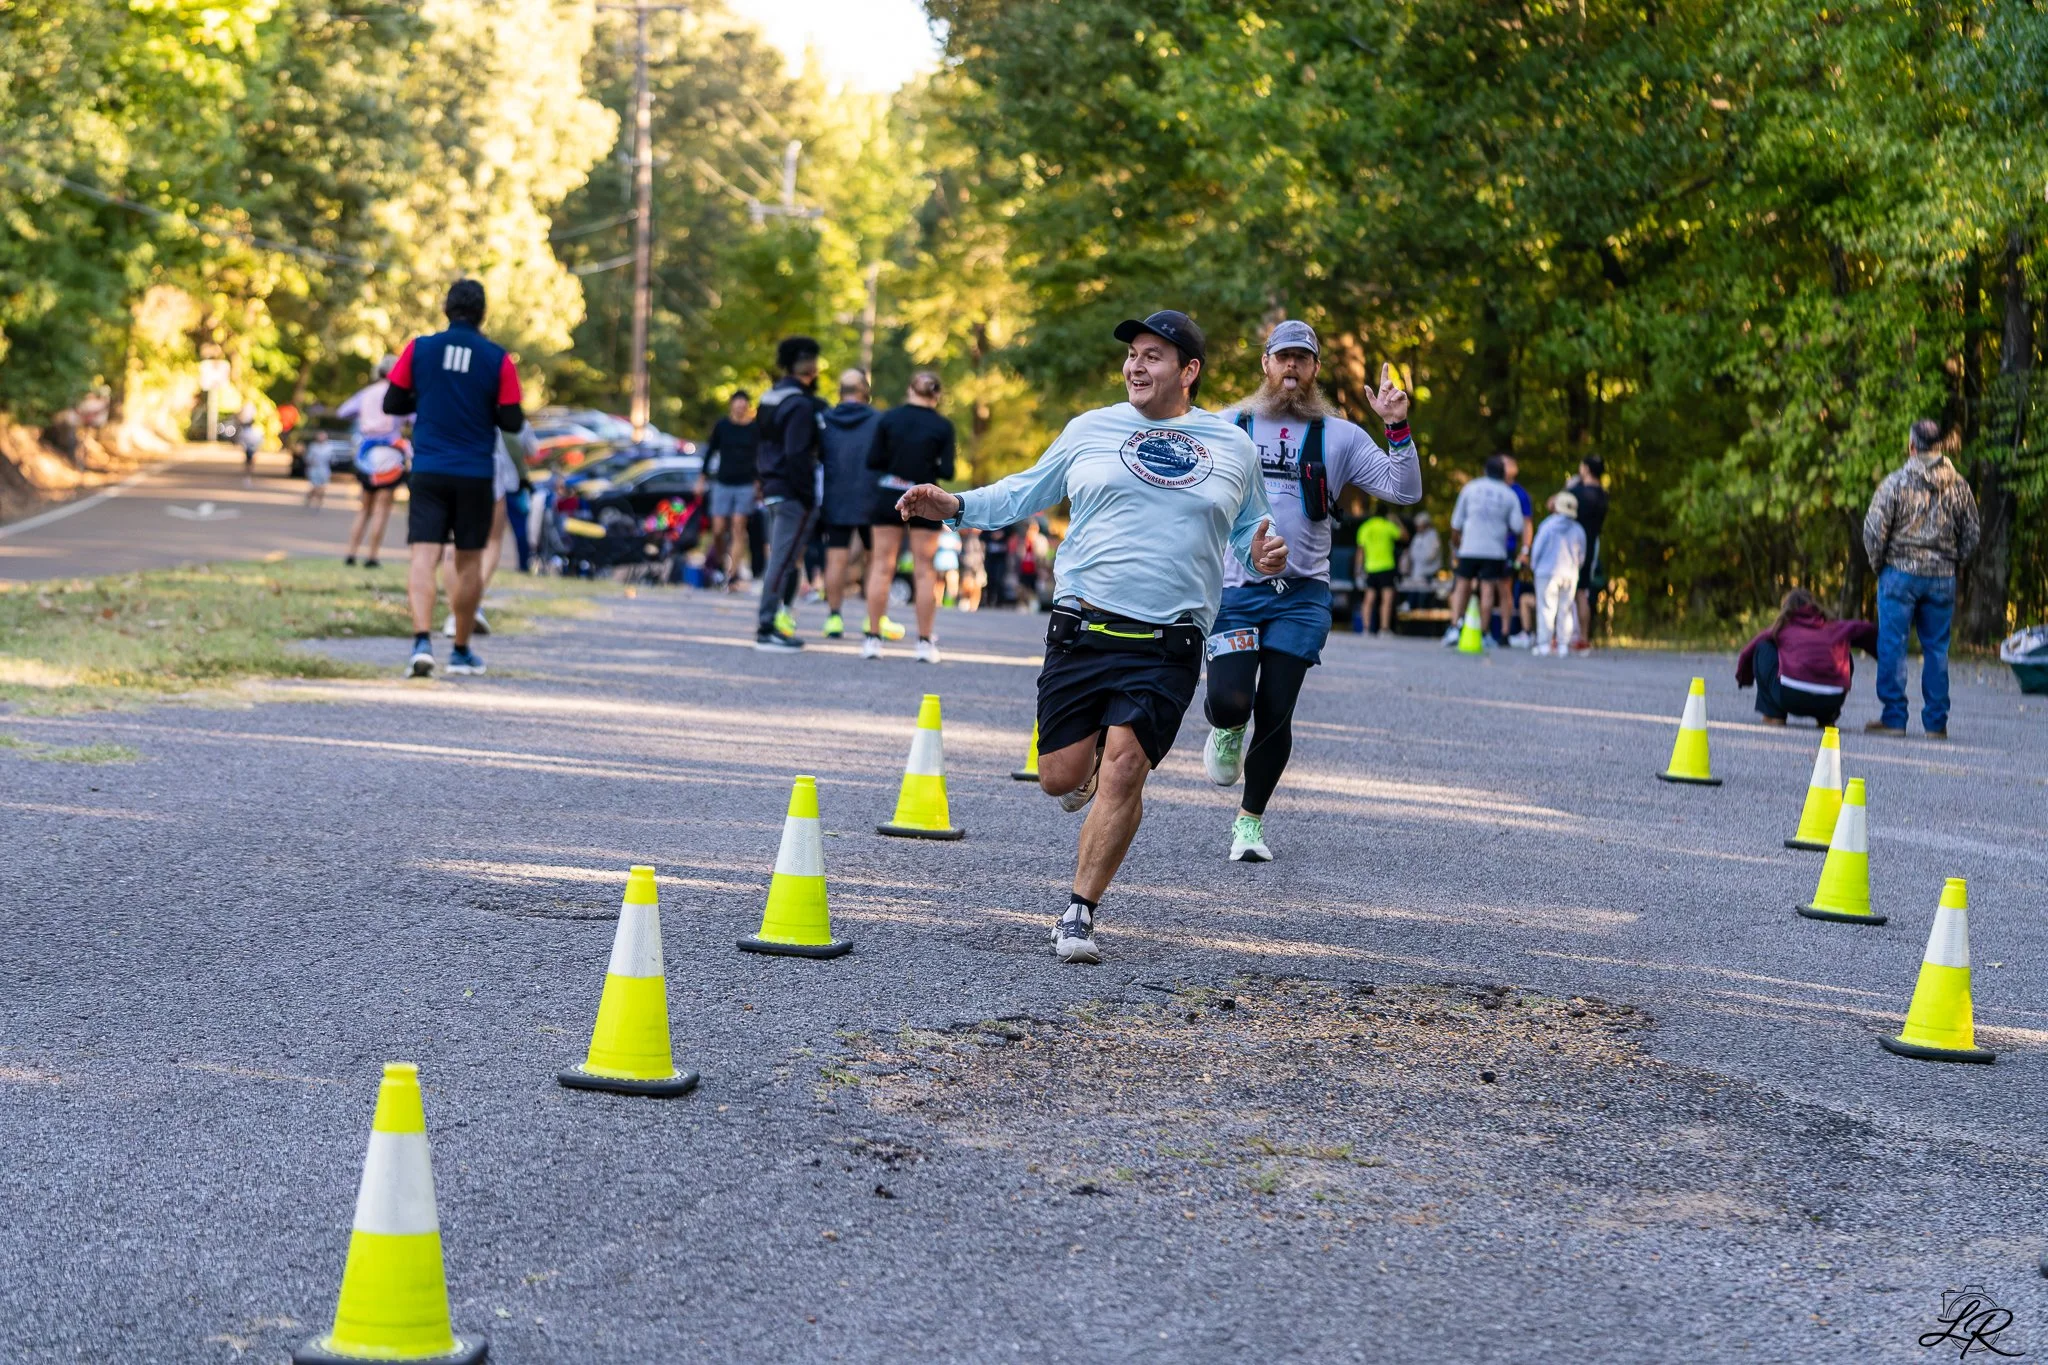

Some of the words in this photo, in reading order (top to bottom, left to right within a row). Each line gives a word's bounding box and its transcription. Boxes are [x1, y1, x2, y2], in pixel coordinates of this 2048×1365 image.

[1127, 432, 1146, 448] RAD
[1166, 432, 1195, 445] SERIES
[1143, 472, 1166, 485] PURSER
[1166, 476, 1197, 486] MEMORIAL
[1228, 635, 1255, 651] 134
